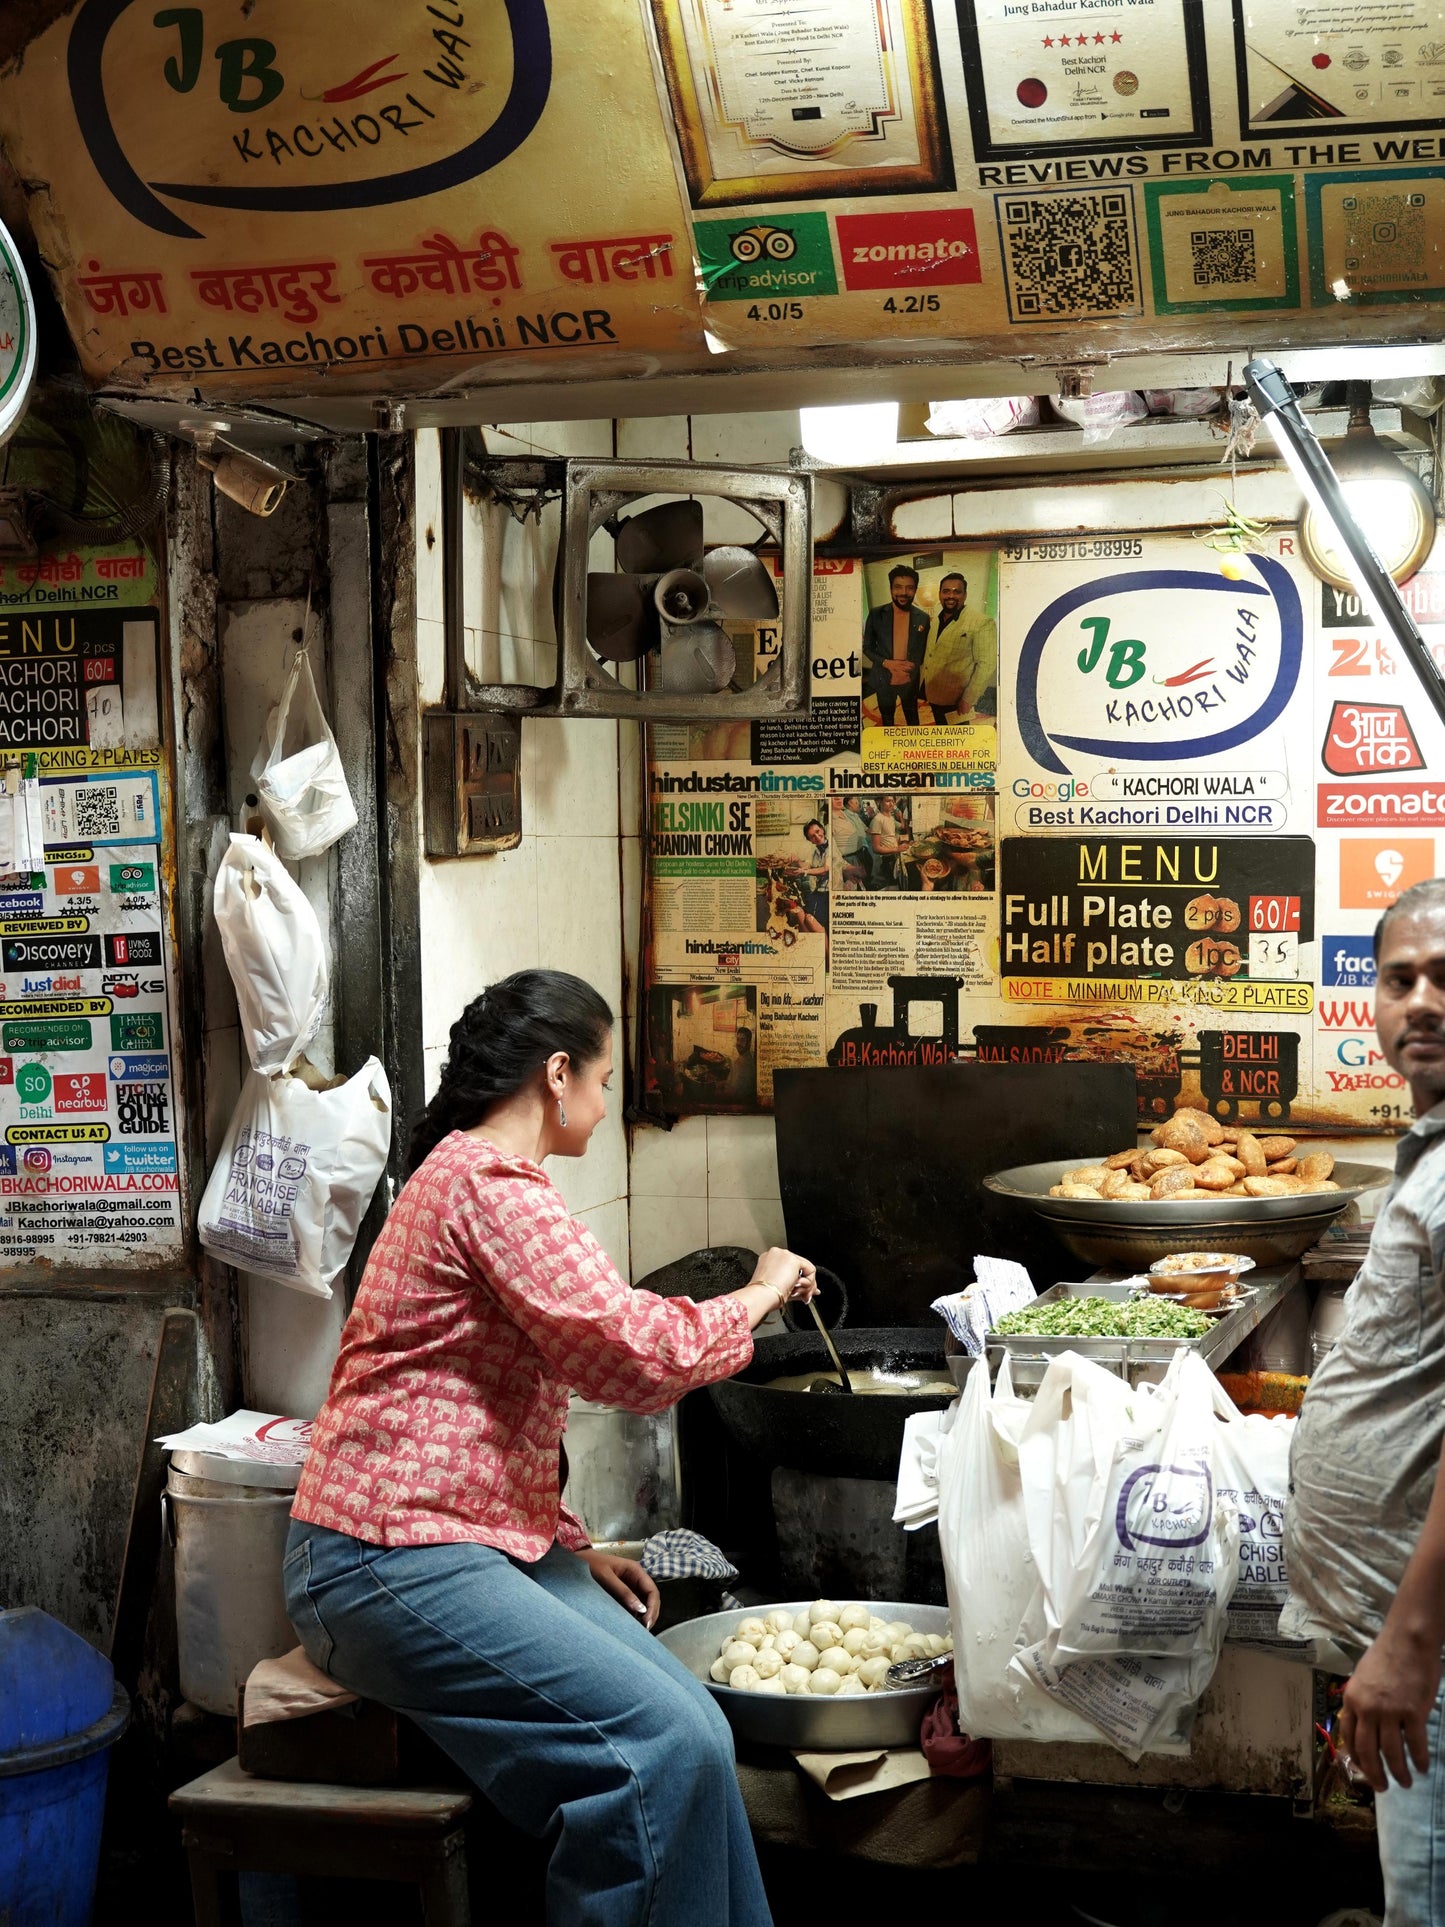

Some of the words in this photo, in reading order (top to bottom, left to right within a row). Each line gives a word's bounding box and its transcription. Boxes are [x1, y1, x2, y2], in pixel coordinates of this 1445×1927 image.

[1004, 4, 1029, 16] Jung
[1031, 2, 1076, 13] Bahadur
[153, 8, 285, 113] JB
[1062, 56, 1077, 66] Best
[1078, 55, 1107, 65] Kachori
[1064, 67, 1086, 76] Delhi
[1087, 65, 1106, 74] NCR
[231, 95, 435, 166] KACHORI
[423, 0, 471, 91] WAL
[979, 154, 1149, 188] REVIEWS
[1162, 148, 1273, 173] FROM
[1284, 143, 1362, 166] THE
[852, 236, 968, 264] zomato
[78, 260, 168, 317] जंग
[191, 261, 342, 324] बहादुर
[550, 234, 675, 285] वाला
[747, 302, 804, 322] 4.0/5
[882, 294, 941, 315] 4.2/5
[130, 339, 227, 371] Best
[232, 327, 388, 368] Kachori
[397, 315, 503, 355] Delhi
[517, 308, 618, 346] NCR
[1278, 538, 1295, 555] R
[35, 588, 77, 602] Delhi
[81, 585, 119, 600] NCR
[83, 642, 90, 654] 2
[94, 643, 115, 656] pcs
[1077, 617, 1147, 690] JB
[1226, 607, 1260, 685] WALA
[86, 661, 113, 681] 60/-
[1107, 684, 1227, 726] KACHORI
[883, 727, 927, 738] RECEIVING
[929, 727, 941, 737] AN
[944, 726, 975, 737] AWARD
[893, 738, 914, 748] FROM
[915, 738, 966, 748] CELEBRITY
[91, 750, 100, 765] 2
[868, 749, 891, 760] CHEF
[903, 750, 945, 760] RANVEER
[946, 750, 971, 759] BRAR
[972, 749, 991, 759] FOR
[863, 761, 884, 771] BEST
[885, 761, 938, 772] KACHORIES
[938, 761, 948, 771] IN
[949, 761, 974, 771] DELHI
[977, 761, 996, 771] NCR
[651, 770, 826, 793] hindustantimes
[1123, 777, 1199, 796] KACHORI
[1204, 777, 1255, 796] WALA
[1013, 779, 1089, 802] Google
[729, 802, 751, 832] SE
[1029, 806, 1074, 825] Best
[1080, 806, 1159, 825] Kachori
[1166, 806, 1218, 824] Delhi
[1225, 805, 1272, 824] NCR
[705, 833, 753, 856] CHOWK
[1079, 844, 1218, 882] MENU
[67, 896, 91, 906] 4.3/5
[1005, 895, 1069, 927] Full
[1083, 896, 1173, 928] Plate
[1188, 906, 1198, 921] 2
[1204, 906, 1233, 926] pcs
[1253, 896, 1300, 930] 60/-
[4, 920, 64, 933] REVIEWED
[66, 919, 83, 931] BY
[128, 939, 150, 949] LIVING
[1005, 932, 1076, 964] Half
[1087, 935, 1175, 972] plate
[45, 961, 84, 969] CHANNEL
[20, 976, 81, 992] Justdial
[102, 974, 139, 982] NDTV
[1009, 981, 1054, 998] NOTE
[1067, 983, 1143, 1001] MINIMUM
[1227, 987, 1238, 1004] 2
[1243, 987, 1309, 1006] PLATES
[90, 1001, 106, 1012] BY
[759, 1012, 773, 1022] Jung
[774, 1012, 797, 1021] Bahadur
[798, 1012, 819, 1021] Kachori
[8, 1026, 70, 1034] RECOMMENDED
[72, 1025, 83, 1033] ON
[29, 1036, 86, 1049] tripadvisor
[1223, 1034, 1278, 1060] DELHI
[128, 1061, 168, 1077] magicpin
[25, 1077, 46, 1092] SO
[1221, 1074, 1234, 1095] &
[1240, 1071, 1280, 1095] NCR
[20, 1106, 53, 1119] Delhi
[58, 1098, 107, 1112] nearbuy
[118, 1104, 168, 1122] OUT
[12, 1130, 68, 1140] CONTACT
[72, 1129, 86, 1138] US
[89, 1128, 104, 1138] AT
[119, 1121, 169, 1133] GUIDE
[124, 1145, 146, 1153] follow
[53, 1154, 93, 1163] Instagram
[125, 1153, 174, 1166] twitter
[136, 1165, 174, 1173] Kachoriwala
[230, 1170, 297, 1202] FRANCHISE
[5, 1199, 171, 1213] JBkachoriwala@gmail.com
[18, 1216, 174, 1230] Kachoriwala@yahoo.com
[68, 1234, 147, 1244] +91-79821-42903
